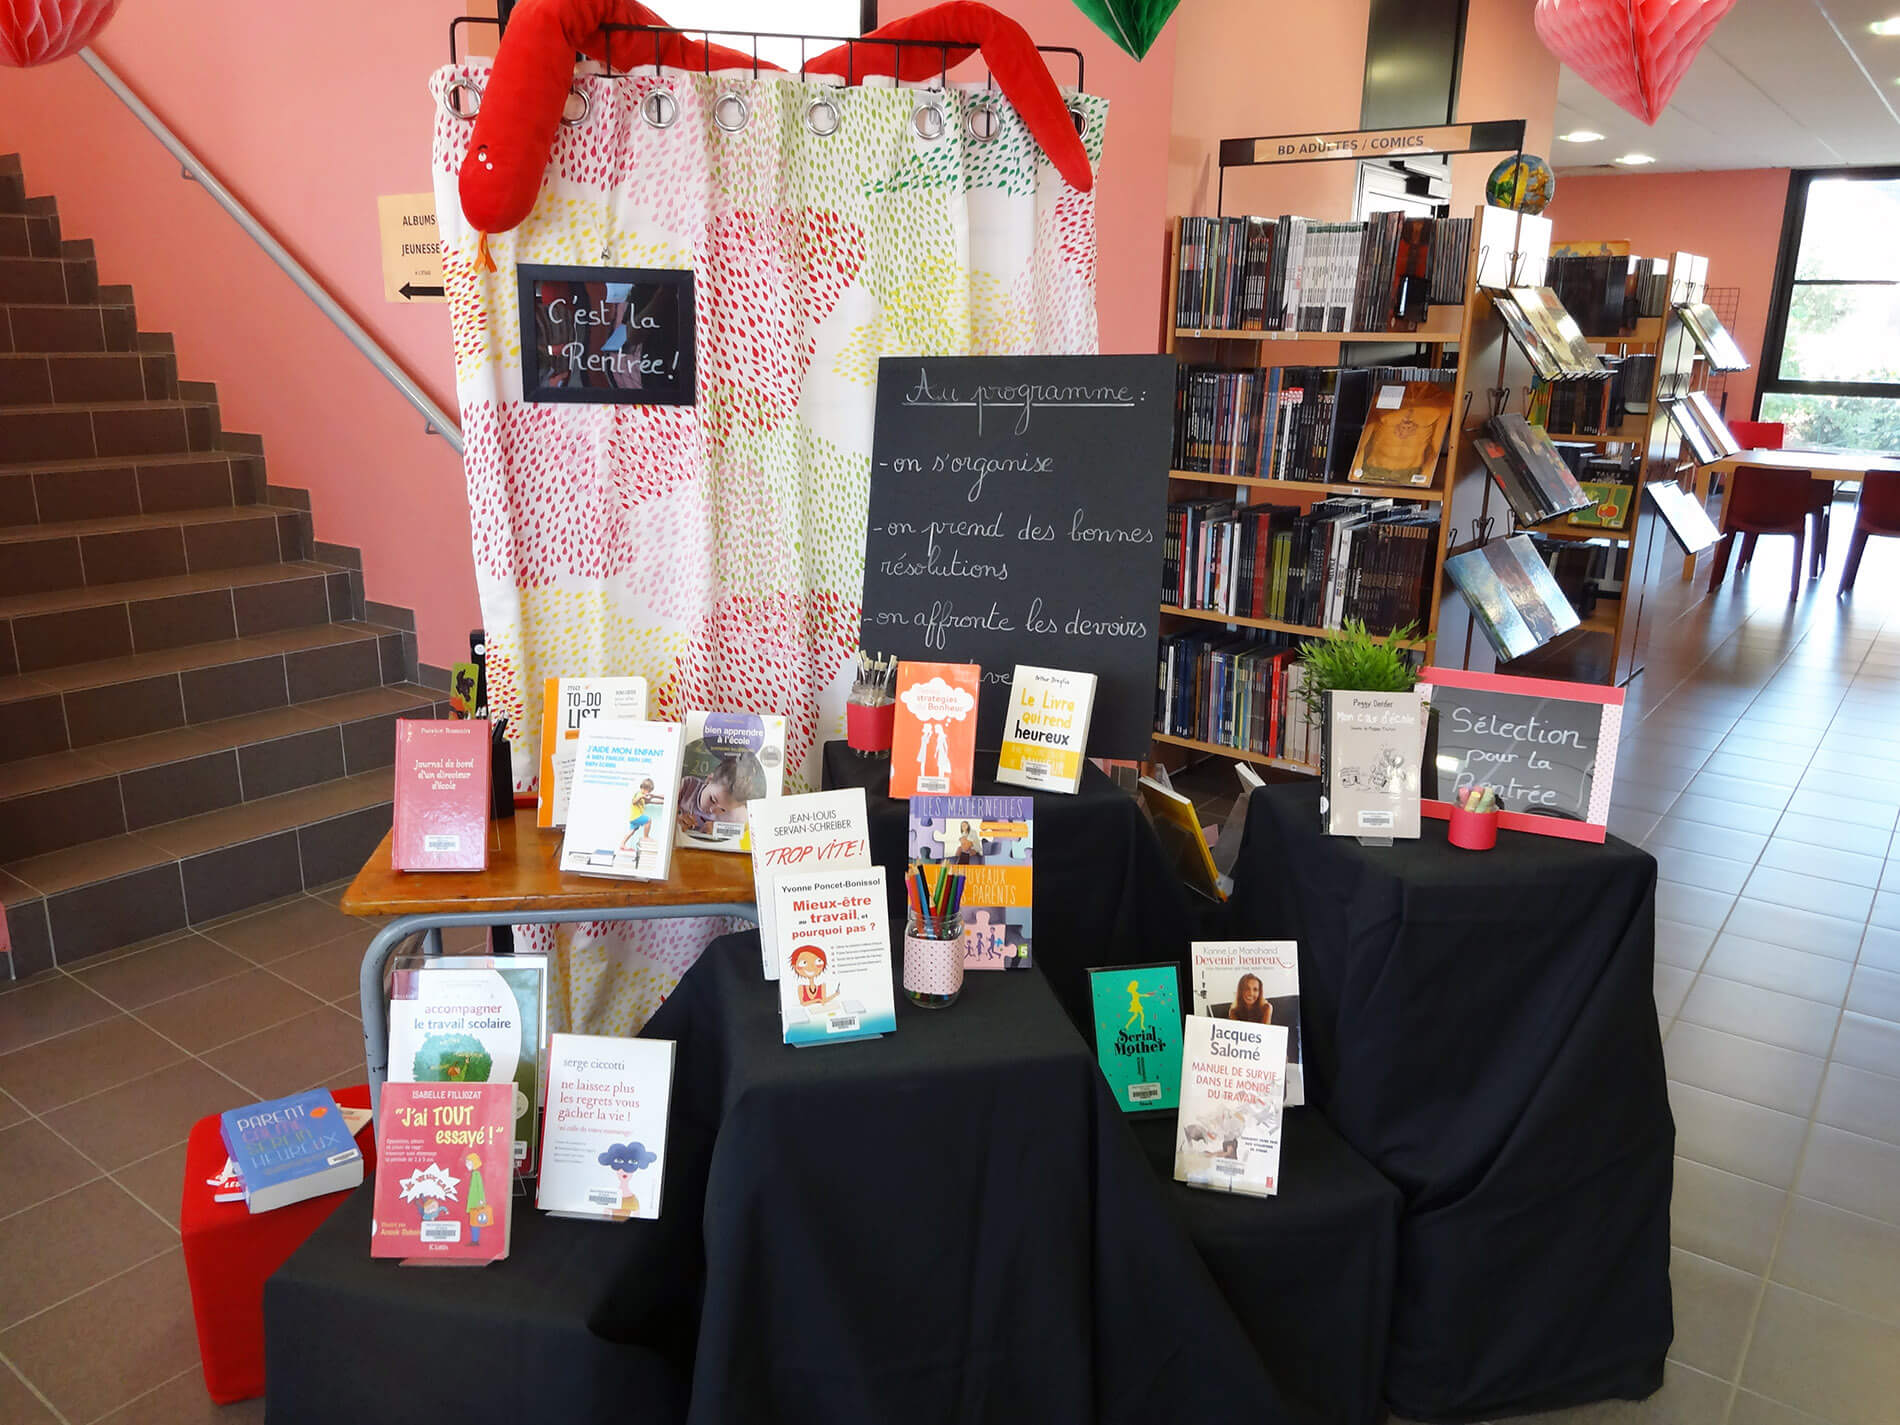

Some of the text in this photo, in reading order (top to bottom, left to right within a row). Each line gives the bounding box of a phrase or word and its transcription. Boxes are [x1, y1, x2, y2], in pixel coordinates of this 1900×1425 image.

[1277, 145, 1294, 155] BD
[1371, 135, 1424, 150] COMICS
[402, 214, 436, 226] ALBUMS
[401, 243, 440, 256] JEUNESSE
[548, 295, 660, 329] C'est la
[906, 367, 959, 404] Au
[932, 452, 1054, 502] s'organise
[921, 511, 1004, 557] prend
[1017, 513, 1055, 541] des
[1067, 508, 1154, 543] bonnes
[880, 545, 1008, 580] résolutions
[914, 599, 1015, 650] affronte
[1024, 597, 1058, 634] les
[1065, 607, 1148, 639] devoirs
[566, 692, 602, 707] TO-DO
[1020, 687, 1075, 711] Le Livre
[1022, 711, 1072, 729] qui rend
[1451, 707, 1587, 749] Sélection
[704, 725, 764, 737] bien apprendre
[717, 734, 751, 745] à l'école
[1014, 719, 1070, 745] heureux
[612, 746, 632, 755] MON
[634, 747, 665, 757] ENFANT
[1464, 749, 1553, 770] pour la
[1452, 772, 1557, 806] Rntrée
[789, 810, 837, 824] JEAN-LOUIS
[923, 798, 1023, 818] LES MATERNELLES
[774, 820, 852, 836] SERVAN-SCHREIBER
[765, 845, 813, 866] TROP
[781, 878, 881, 893] Yvonne Poncet-Bonissol
[793, 896, 872, 912] Mieux-être
[792, 926, 842, 940] pourquoi
[846, 925, 866, 935] pas
[1195, 954, 1288, 967] Devenir heureux
[424, 1005, 502, 1017] accompagner
[414, 1017, 512, 1029] le travail scolaire
[1117, 1026, 1157, 1043] Serial
[1210, 1023, 1262, 1045] Jacques
[1114, 1038, 1167, 1056] Mother
[1210, 1041, 1261, 1061] Salomé
[563, 1058, 625, 1072] serge ciccotti
[1191, 1061, 1278, 1081] MANUEL DE SURVIE
[561, 1079, 635, 1097] ne laissez plus
[1196, 1074, 1272, 1093] DANS LE MONDE
[412, 1090, 482, 1099] ISABELLE FILLIOZAT
[560, 1091, 640, 1110] les regrets vous
[1207, 1088, 1257, 1105] DU TRAVAIL
[236, 1104, 305, 1132] PARENT
[432, 1105, 475, 1126] TOUT
[557, 1106, 594, 1122] gâcher
[597, 1108, 606, 1120] la
[609, 1109, 625, 1121] vie
[436, 1125, 485, 1148] essayé
